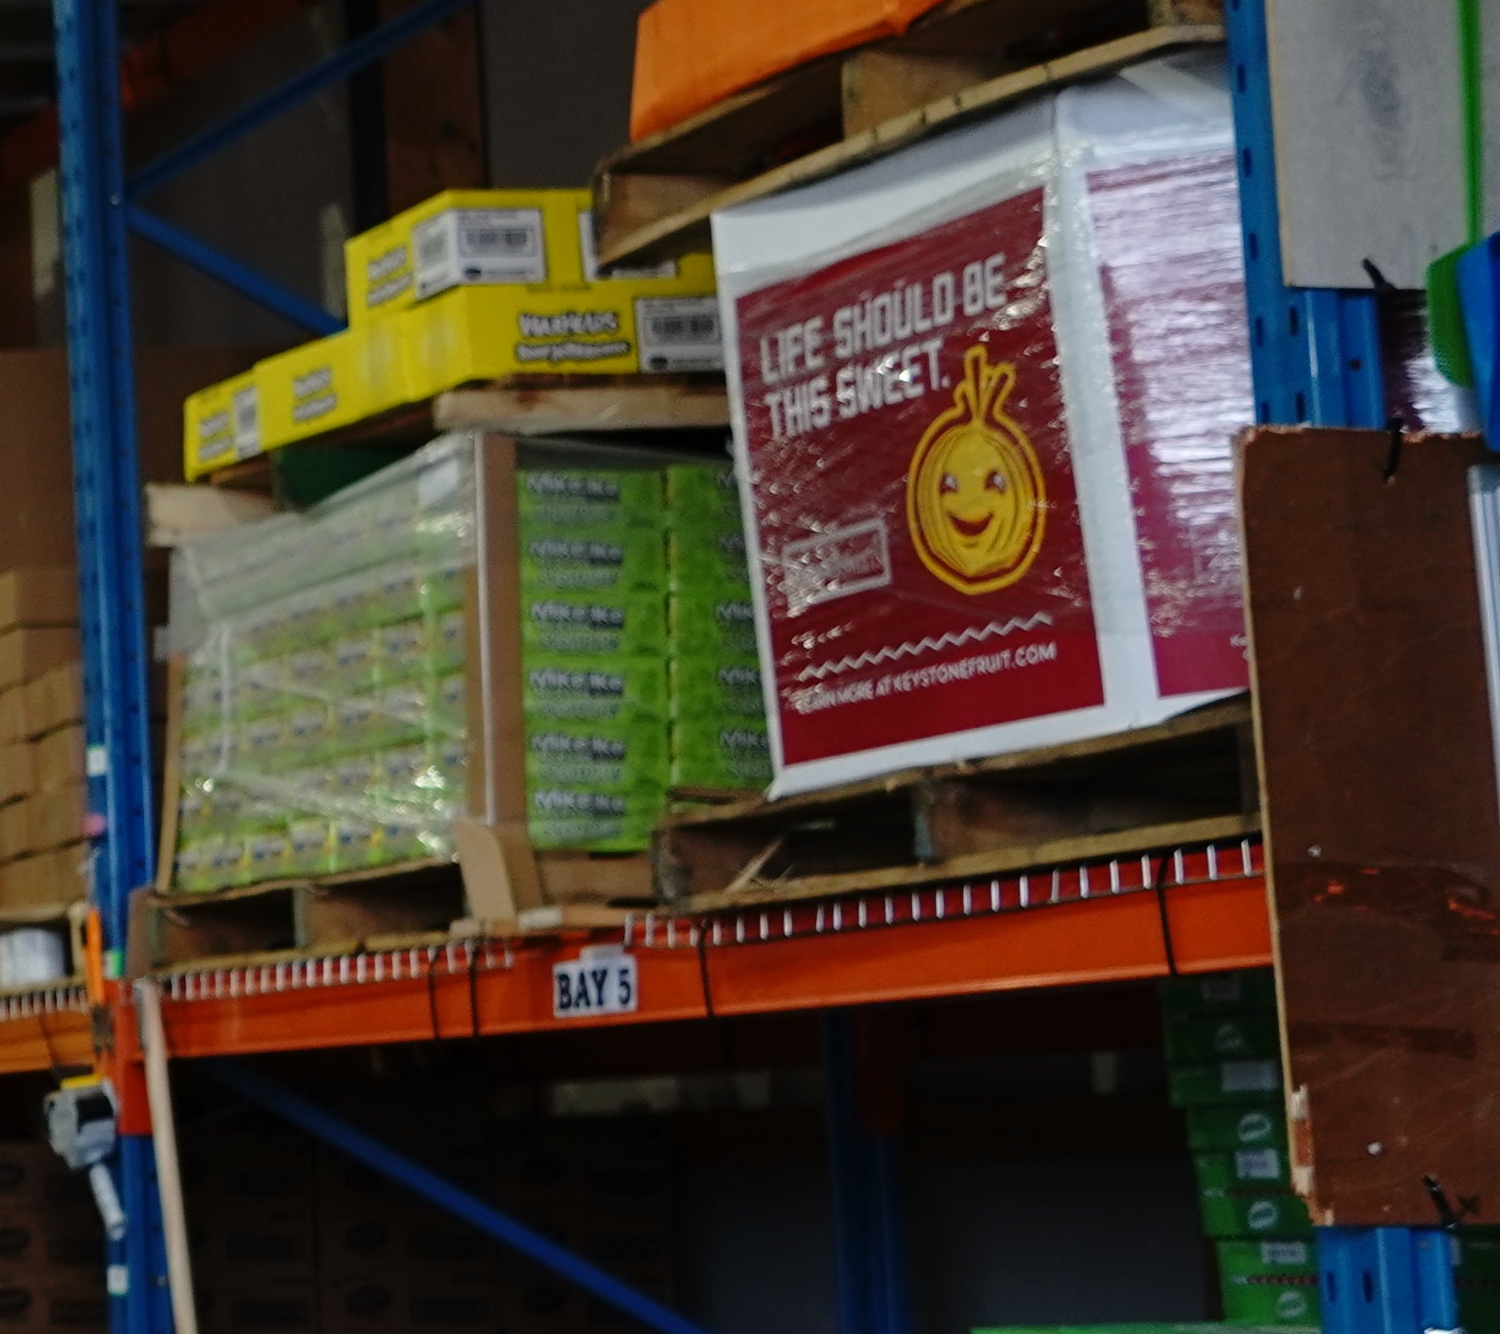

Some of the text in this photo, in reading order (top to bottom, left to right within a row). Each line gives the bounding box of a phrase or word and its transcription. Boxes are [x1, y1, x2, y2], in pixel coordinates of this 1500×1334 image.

[761, 252, 1007, 385] LIFE SHOULD BE
[764, 375, 831, 442] THIS
[892, 641, 1057, 694] KEYSTONEFRUIT.COM
[558, 968, 632, 1010] BAY 5
